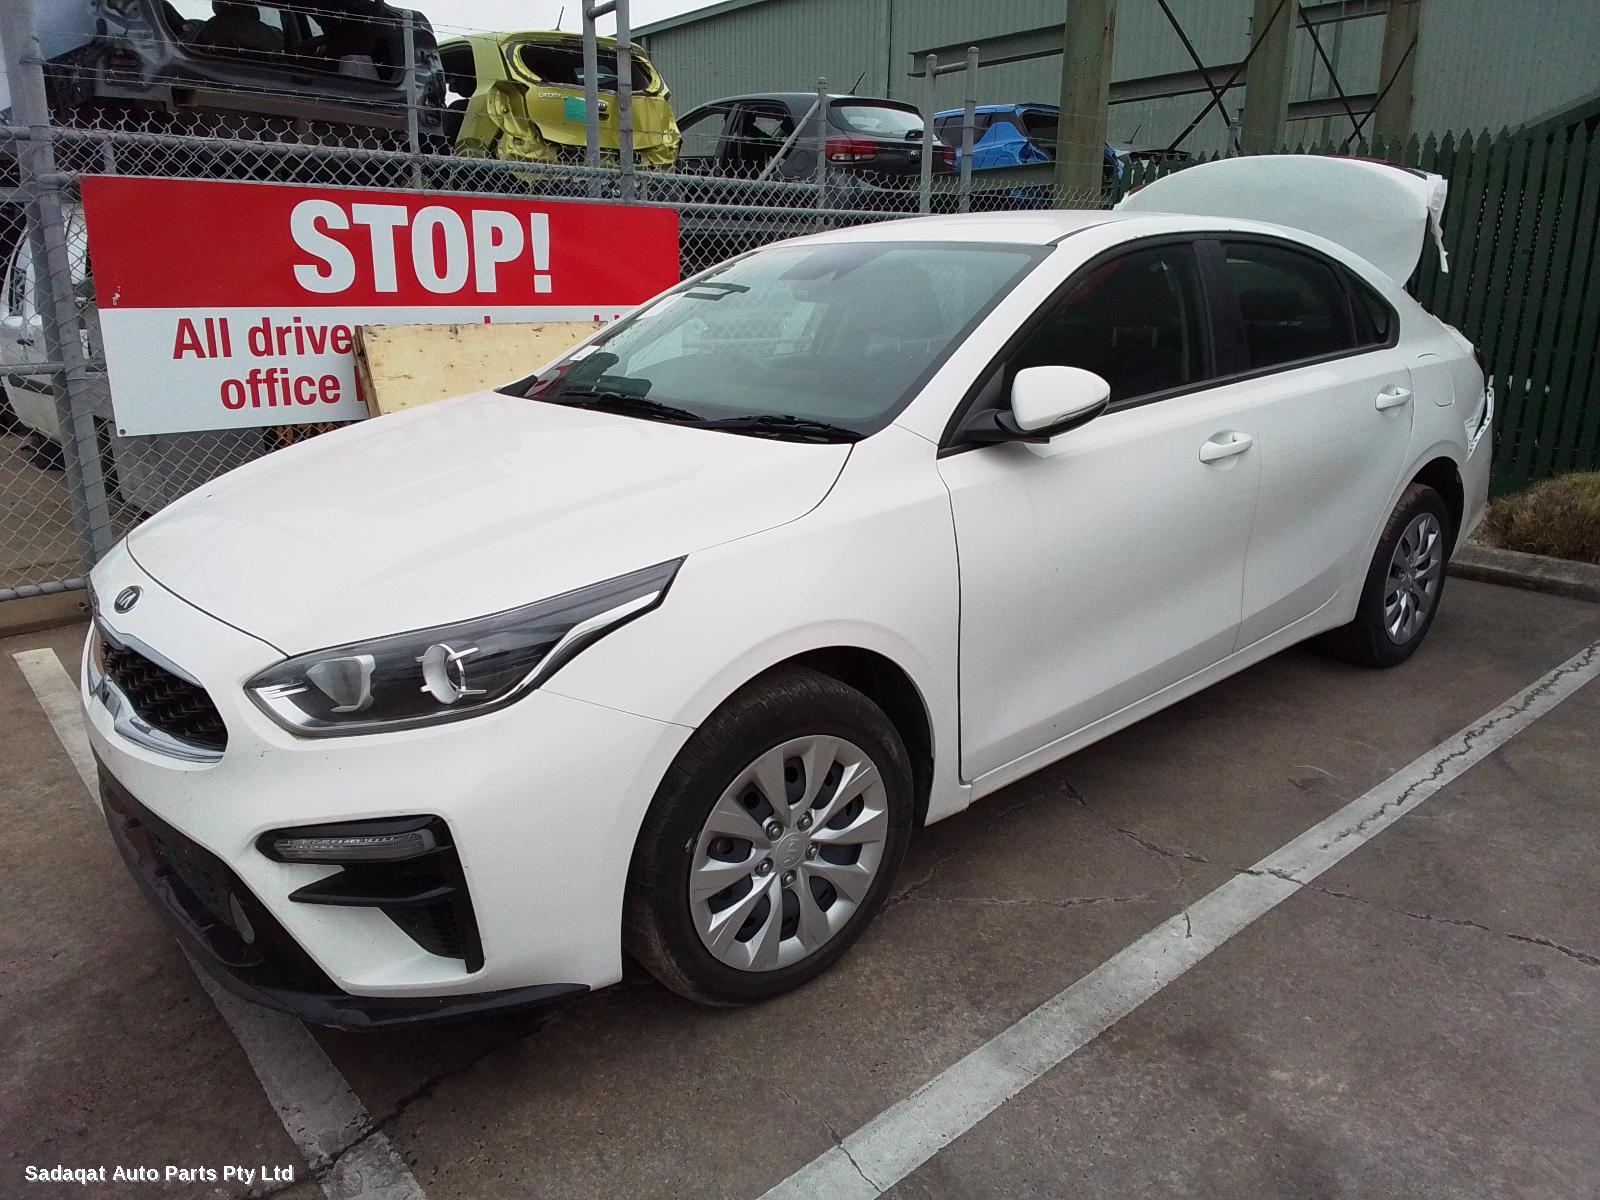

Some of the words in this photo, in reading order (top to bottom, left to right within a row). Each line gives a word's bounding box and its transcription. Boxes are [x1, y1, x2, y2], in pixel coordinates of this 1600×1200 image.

[290, 199, 552, 294] STOP!
[172, 317, 232, 359] All
[220, 367, 341, 410] office
